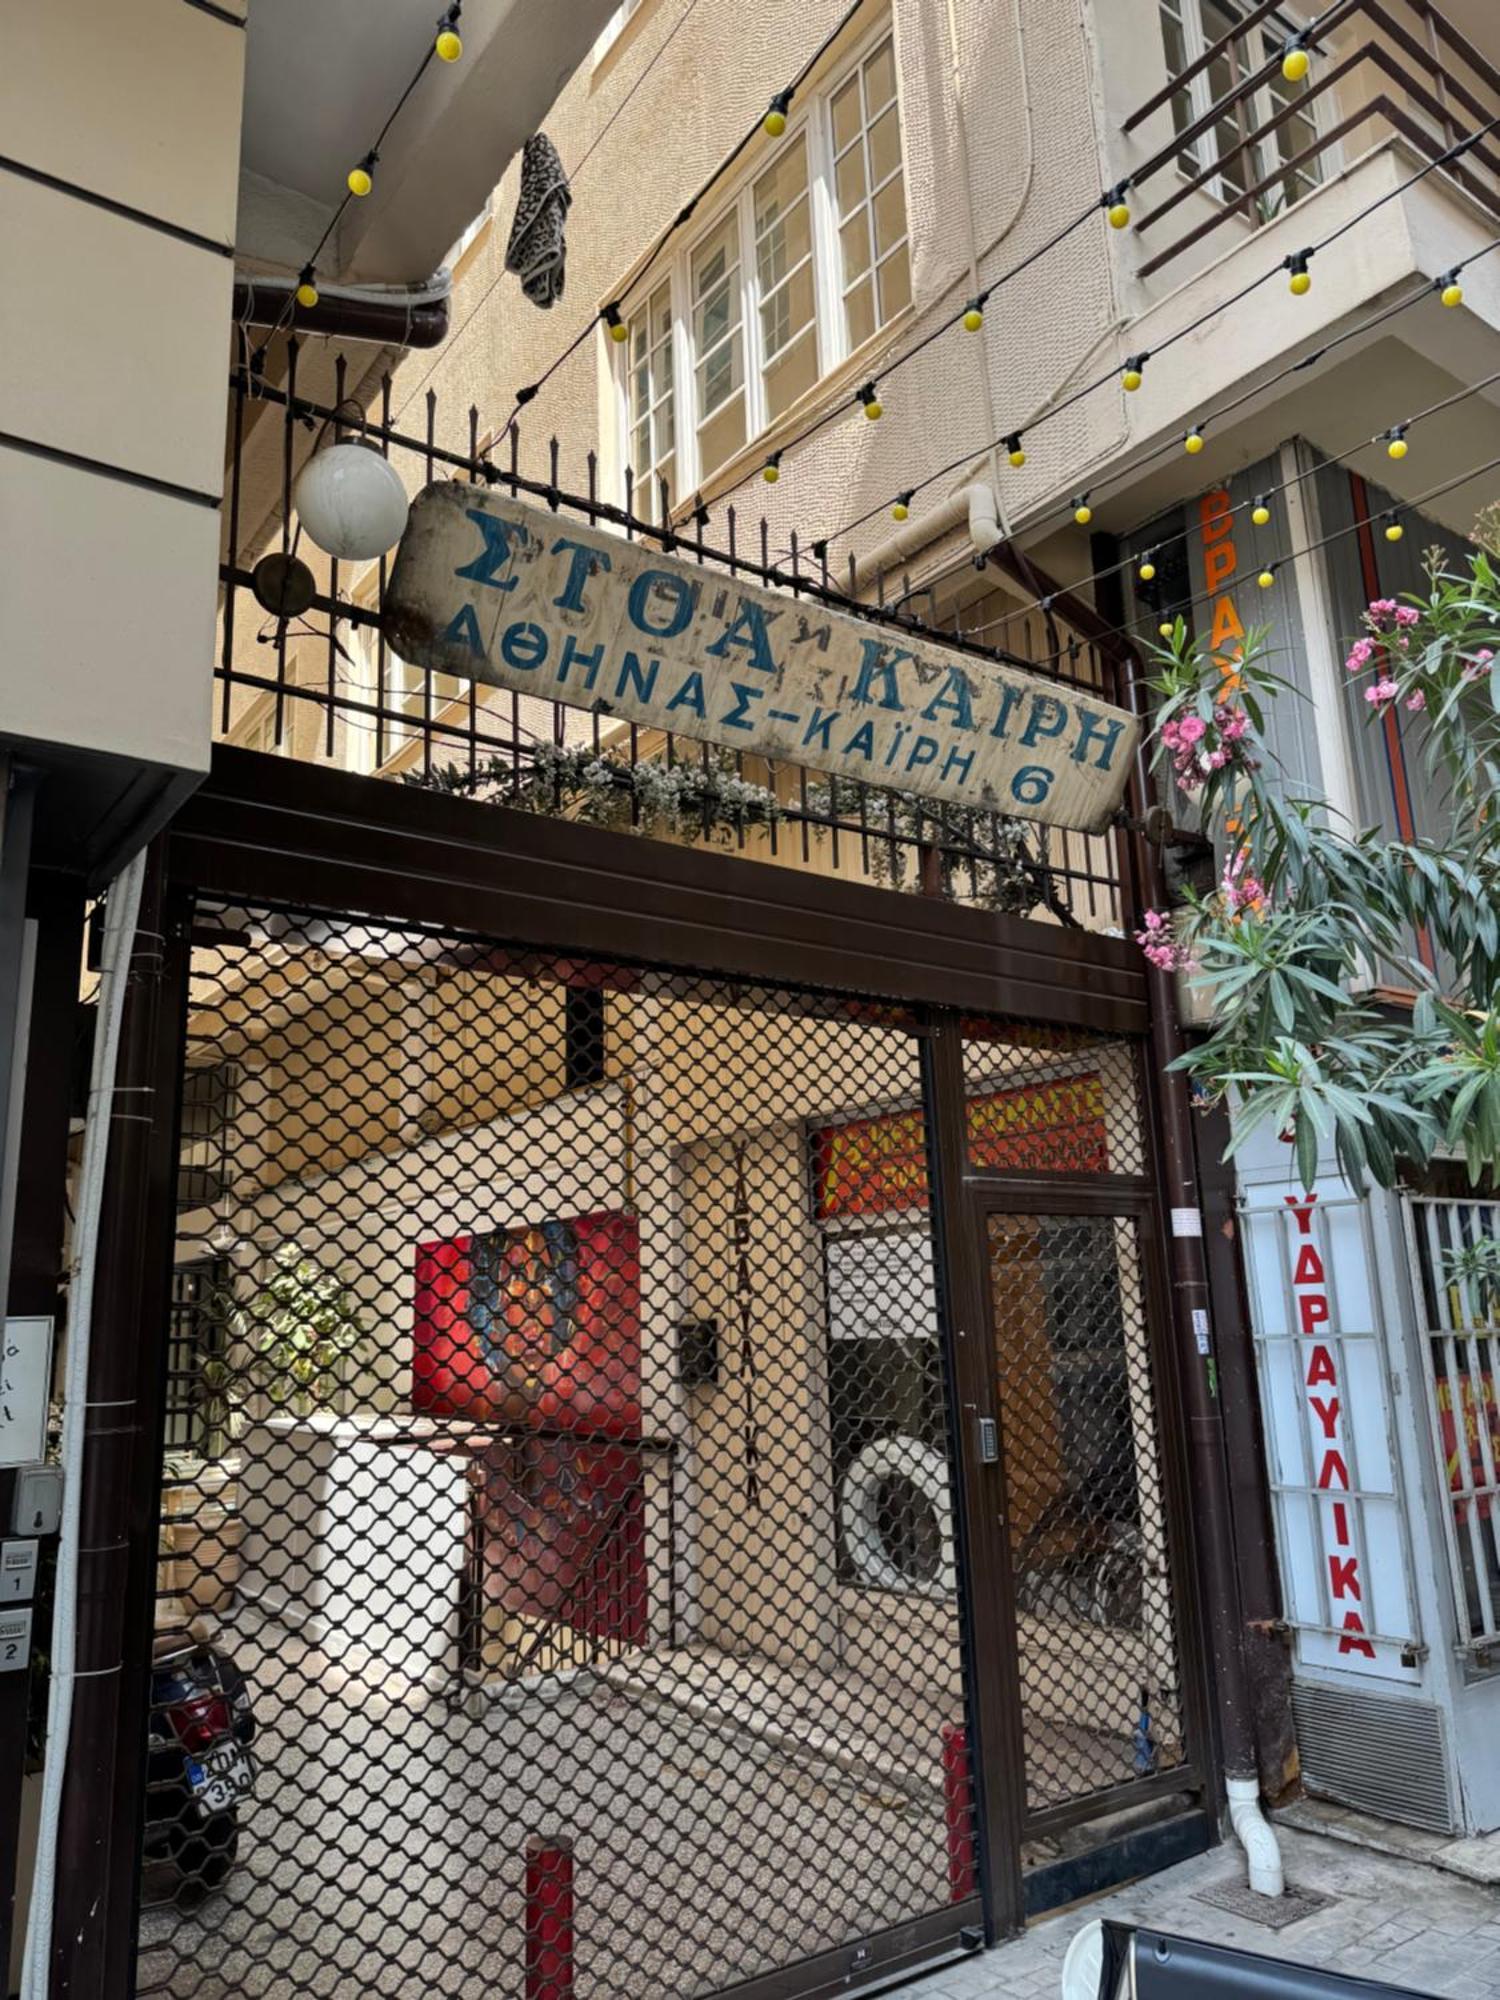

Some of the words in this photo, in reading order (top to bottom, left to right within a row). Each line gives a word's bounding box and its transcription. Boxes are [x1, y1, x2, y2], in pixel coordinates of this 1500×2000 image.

[454, 508, 777, 674] ΣΤΟΑ
[1010, 764, 1056, 806] 6
[1283, 1193, 1377, 1660] ΥΔΡΑΥΛΙΚΑ
[13, 1577, 21, 1591] 1
[5, 1643, 18, 1660] 2
